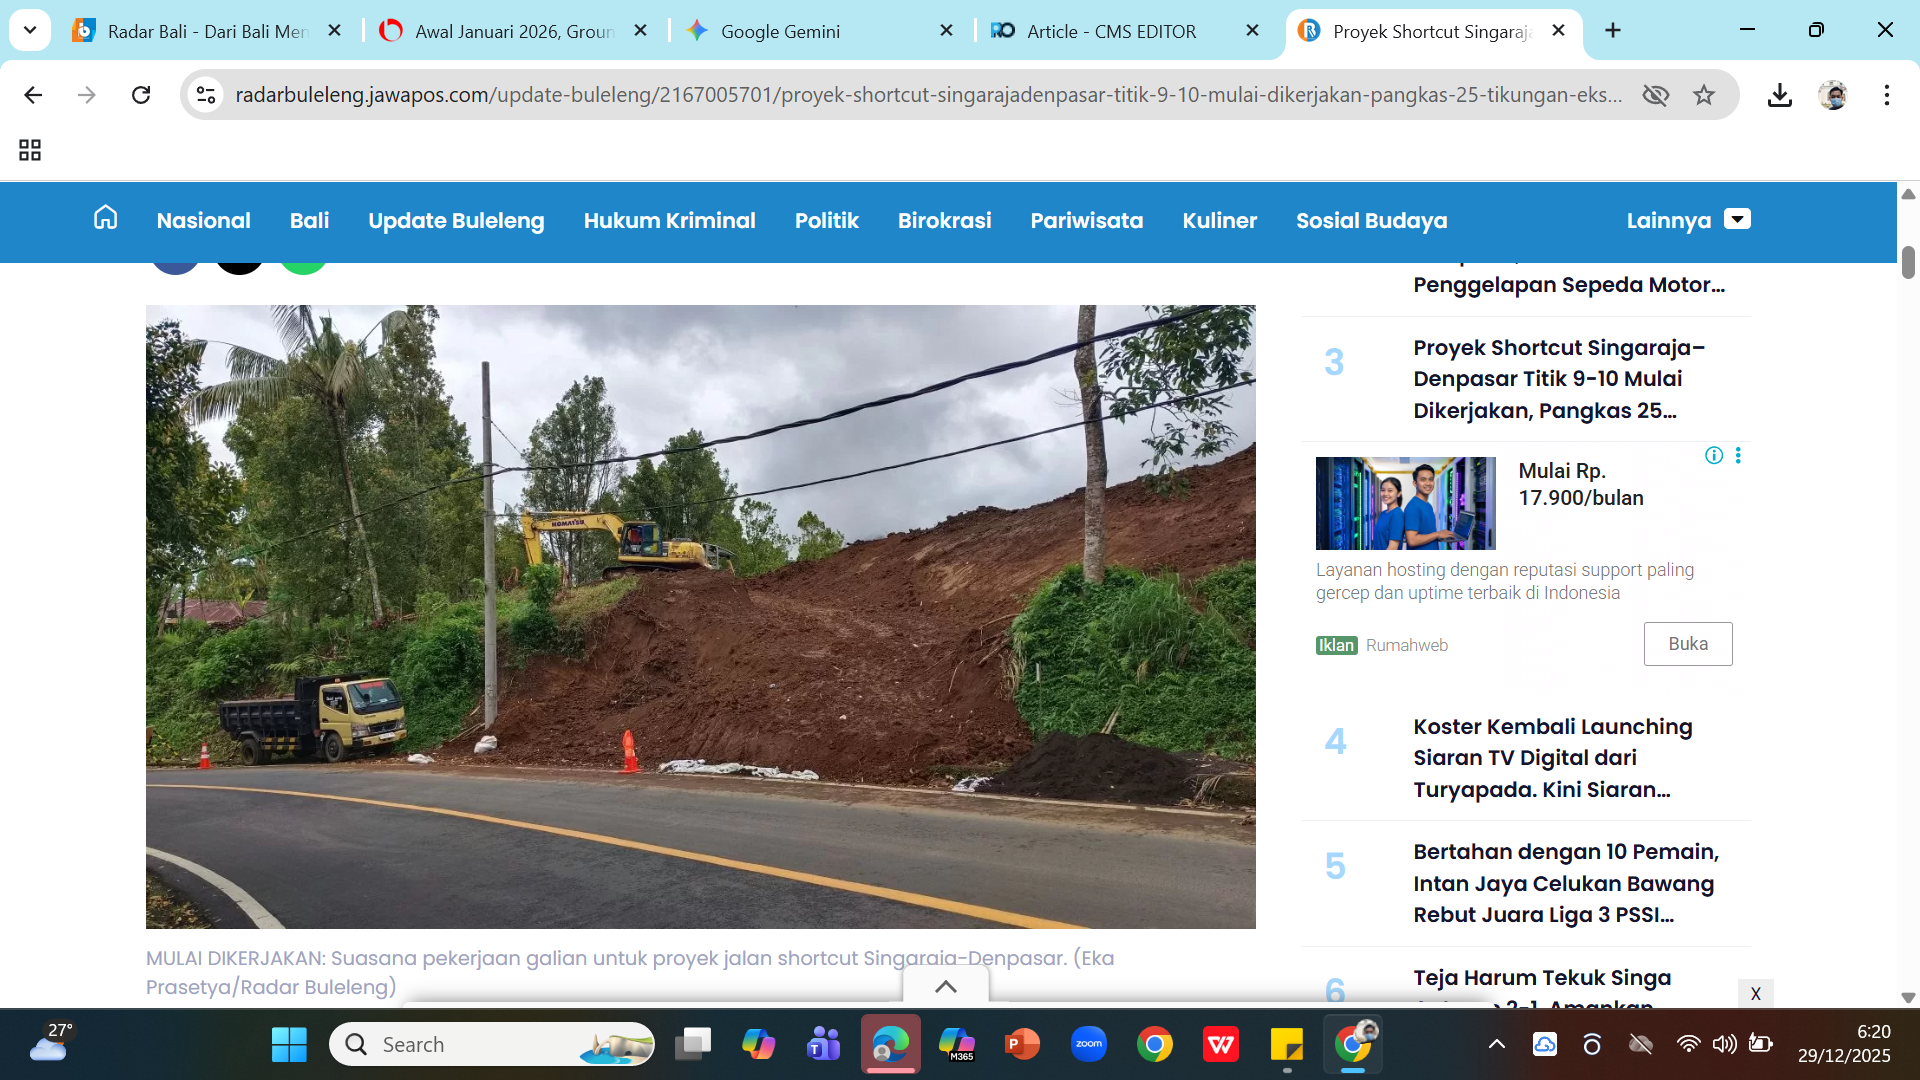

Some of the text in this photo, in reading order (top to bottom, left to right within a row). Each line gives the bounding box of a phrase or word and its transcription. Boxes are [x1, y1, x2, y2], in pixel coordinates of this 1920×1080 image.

[109, 24, 154, 38] Radar
[160, 24, 186, 38] Bali
[205, 25, 236, 38] Dari
[243, 24, 269, 38] Bali
[416, 24, 452, 38] Awal
[458, 25, 513, 38] Januari
[519, 25, 561, 40] 2026,
[722, 24, 840, 42] Google Gemini
[1028, 24, 1078, 38] Article
[1095, 25, 1131, 38] CMS
[1138, 25, 1197, 38] EDITOR
[1335, 24, 1388, 42] Proyek
[1393, 24, 1460, 38] Shortcut
[158, 211, 250, 229] Nasional
[291, 211, 329, 229] Bali
[369, 212, 544, 234] Update Buleleng
[585, 211, 755, 229] Hukum Kriminal
[796, 211, 860, 229] Politik
[899, 211, 991, 229] Birokrasi
[1032, 211, 1143, 229] Pariwisata
[1184, 211, 1258, 229] Kuliner
[1297, 211, 1447, 234] Sosial Budaya
[1628, 211, 1711, 234] Lainnya
[1414, 276, 1556, 298] Penggelapan
[1563, 276, 1643, 298] Sepeda
[1414, 339, 1486, 361] Proyek
[1492, 339, 1582, 356] Shortcut
[1325, 348, 1343, 375] 3
[1414, 369, 1682, 392] Denpasar Titik 9-10 Mulai
[1414, 401, 1533, 424] Dikerjakan,
[1540, 402, 1632, 424] Pangkas
[1519, 462, 1606, 482] Mulai Rp.
[1520, 489, 1643, 506] 17.900/bulan
[551, 519, 585, 528] KOMATSU
[1317, 562, 1694, 580] Layanan hosting dengan reputasi support paling
[1317, 585, 1620, 603] gercep dan uptime terbaik di Indonesia
[1320, 638, 1354, 651] Iklan
[1367, 638, 1448, 651] Rumahweb
[1670, 636, 1708, 650] Buka
[1414, 717, 1692, 740] Koster Kembali Launching
[1325, 728, 1346, 754] 4
[1414, 748, 1637, 771] Siaran TV Digital dari
[1414, 781, 1537, 803] Turyapada.
[1543, 780, 1581, 797] Kini
[1414, 842, 1719, 865] Bertahan dengan 10 Pemain,
[1327, 852, 1345, 879] 5
[1414, 875, 1714, 897] Intan Jaya Celukan Bawang
[1414, 906, 1476, 923] Rebut
[1482, 907, 1543, 922] Juara
[1550, 905, 1592, 928] Liga
[1599, 906, 1610, 922] 3
[147, 951, 201, 965] MULAI
[209, 951, 325, 965] DIKERJAKAN:
[332, 951, 416, 965] Suasana
[424, 950, 520, 970] pekerjaan
[527, 950, 586, 970] galian
[594, 950, 647, 965] untuk
[654, 950, 718, 970] proyek
[723, 950, 771, 970] jalan
[778, 950, 858, 965] shortcut
[1074, 947, 1114, 969] (Eka
[147, 975, 395, 999] Prasetya/Radar Buleleng)
[1414, 968, 1671, 991] Teja Harum Tekuk Singa
[1325, 977, 1346, 1002] 6
[1751, 987, 1761, 1000] X
[1858, 1025, 1891, 1038] 6:20
[384, 1036, 444, 1052] Search
[1009, 1038, 1018, 1050] P
[1075, 1039, 1103, 1049] zoom
[950, 1051, 974, 1062] M365
[1799, 1049, 1890, 1064] 29/12/2025
